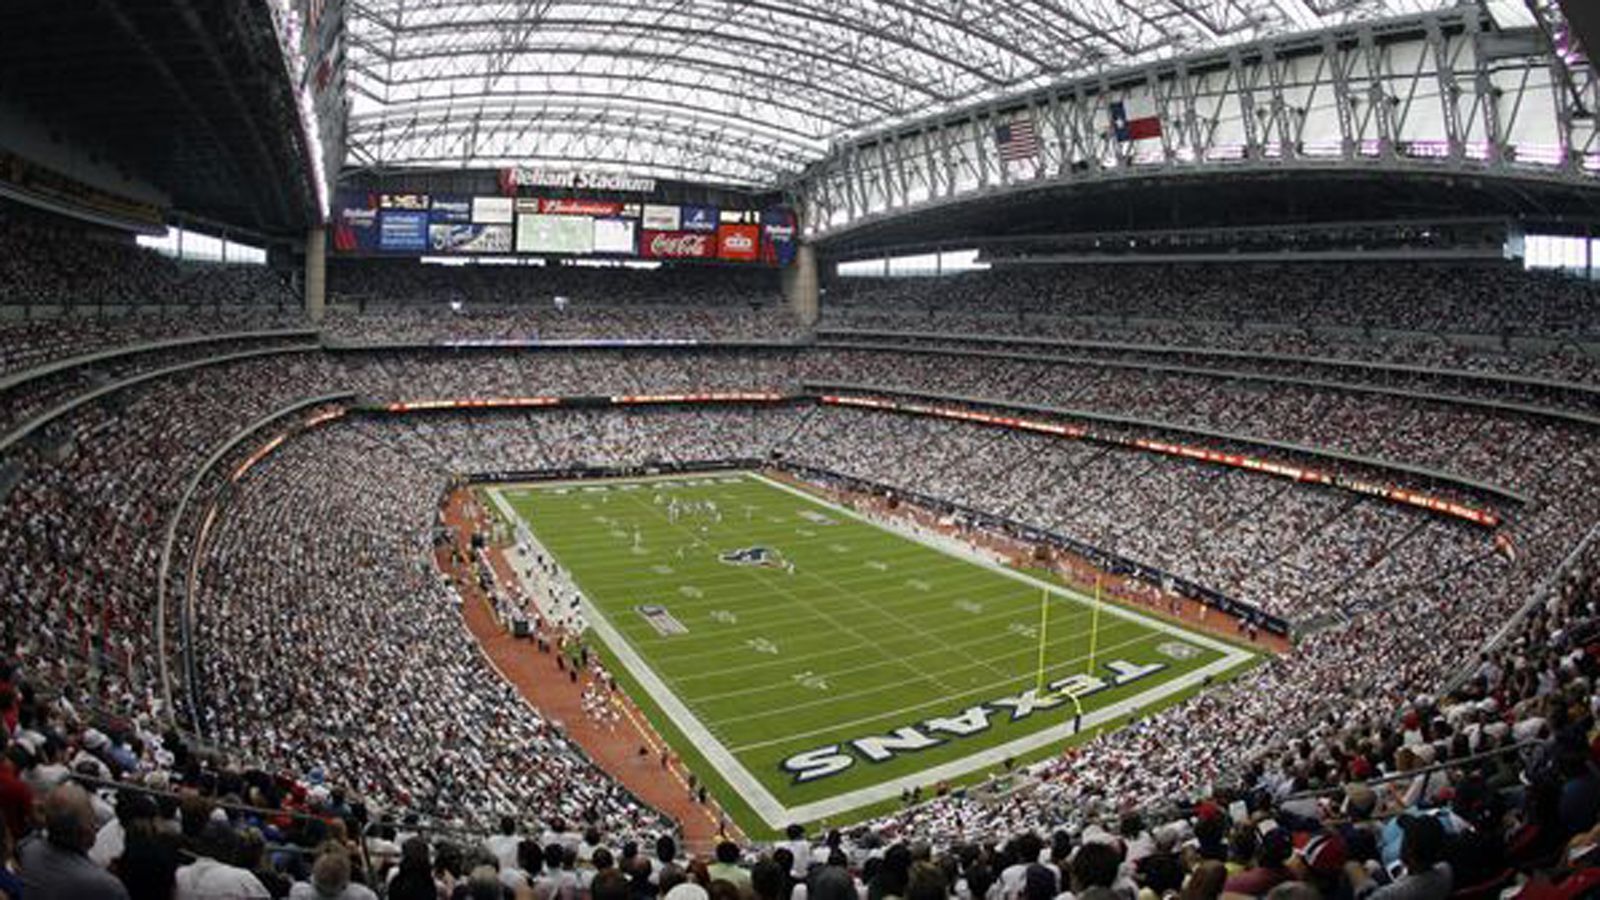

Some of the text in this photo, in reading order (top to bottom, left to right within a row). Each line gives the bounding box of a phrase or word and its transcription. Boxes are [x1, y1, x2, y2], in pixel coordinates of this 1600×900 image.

[508, 167, 657, 192] Reliant Stadium
[781, 659, 1168, 783] TEXANS
